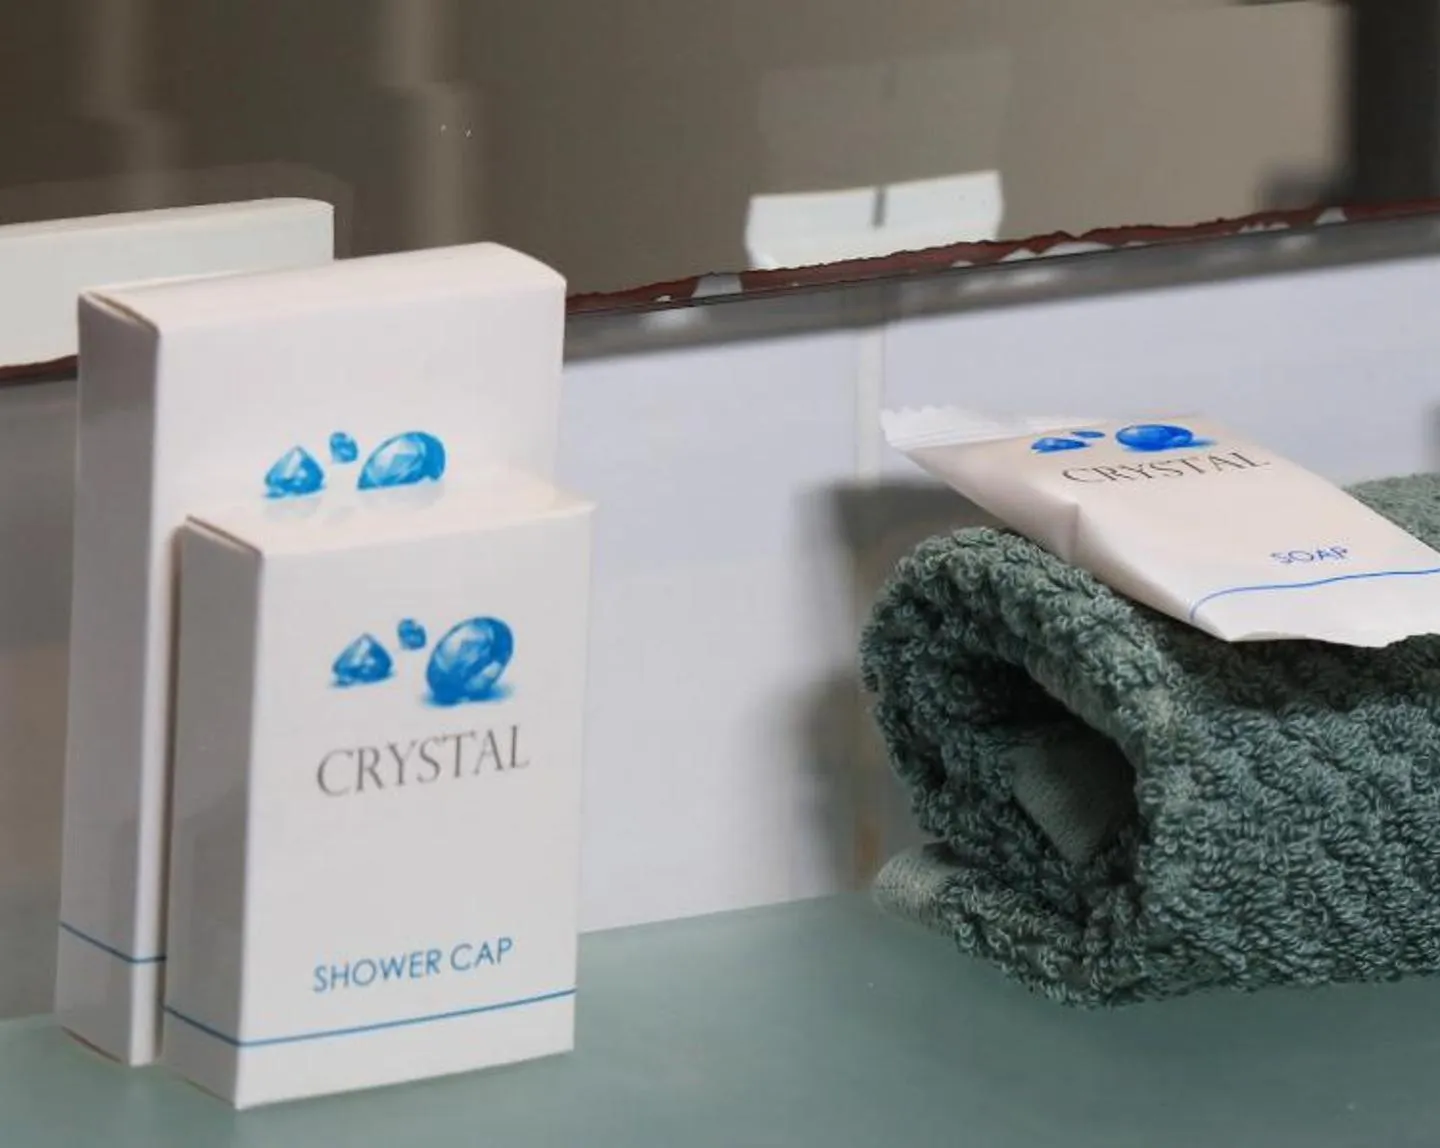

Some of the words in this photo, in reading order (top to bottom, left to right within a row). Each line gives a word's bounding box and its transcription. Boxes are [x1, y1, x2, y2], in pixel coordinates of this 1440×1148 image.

[1062, 450, 1271, 484] CRYSTAL
[1270, 546, 1350, 565] SOAP
[316, 724, 530, 797] CRYSTAL
[312, 947, 443, 993] SHOWER
[449, 936, 513, 973] CAP
